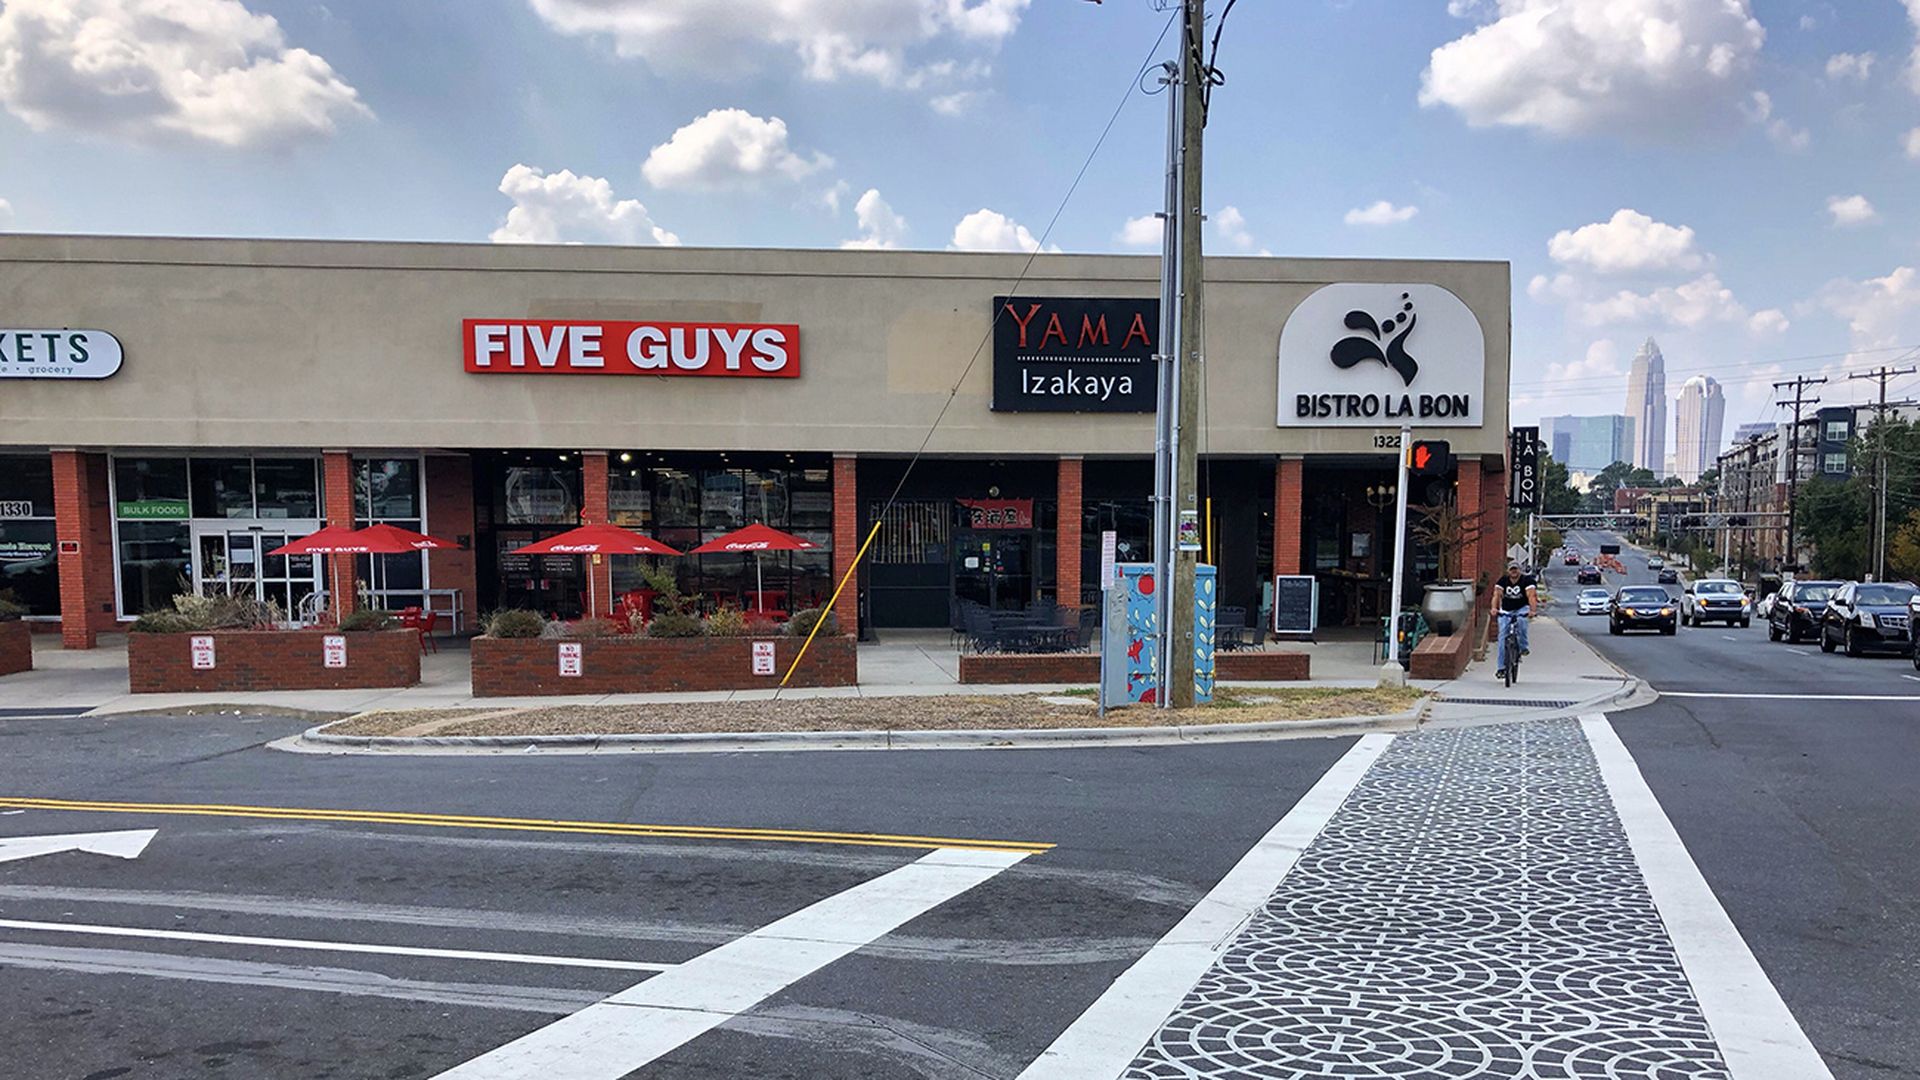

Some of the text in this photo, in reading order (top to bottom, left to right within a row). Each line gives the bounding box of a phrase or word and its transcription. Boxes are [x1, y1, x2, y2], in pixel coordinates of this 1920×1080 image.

[1004, 304, 1151, 350] YAMA
[474, 325, 788, 371] FIVE GUYS
[1022, 368, 1133, 401] Izakaya
[1296, 394, 1470, 418] BISTRO LA BON
[1521, 431, 1534, 503] LA BON
[0, 502, 31, 516] 1330
[123, 506, 185, 514] BULK FOODS
